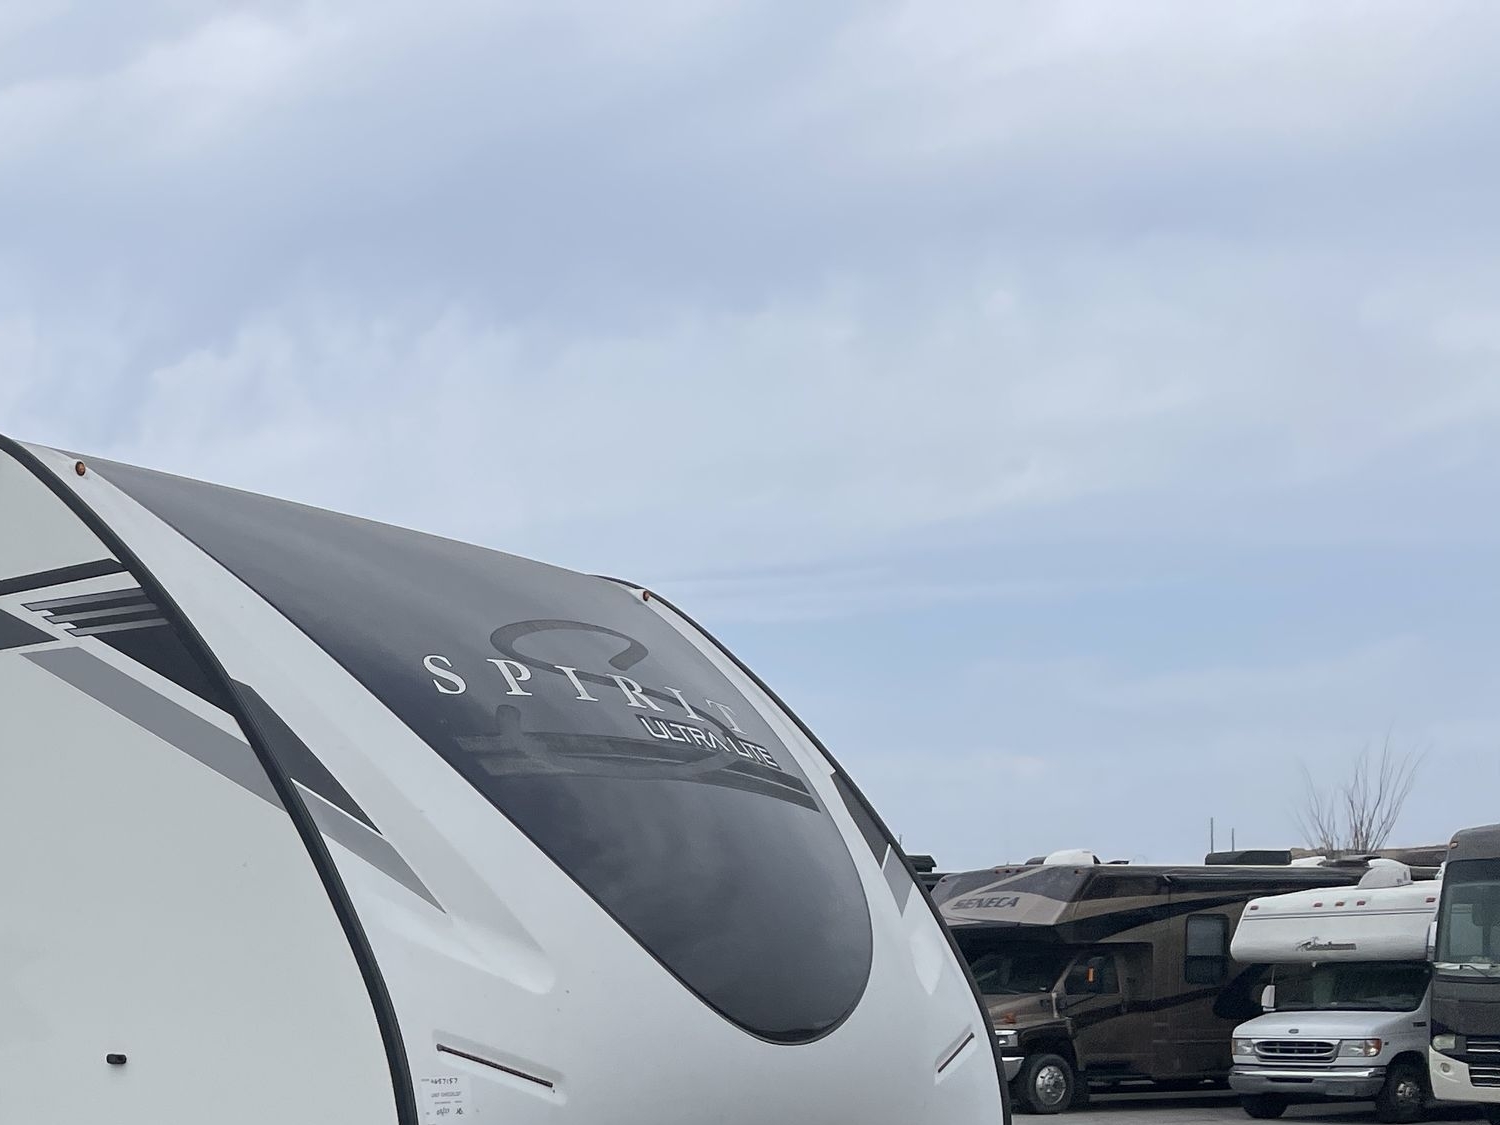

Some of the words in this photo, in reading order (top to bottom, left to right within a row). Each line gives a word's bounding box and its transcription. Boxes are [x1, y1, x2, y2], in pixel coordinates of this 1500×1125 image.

[422, 654, 748, 735] SPIRIT
[638, 716, 731, 752] ULTRA
[726, 736, 780, 768] LITE
[951, 896, 1020, 910] SENECA
